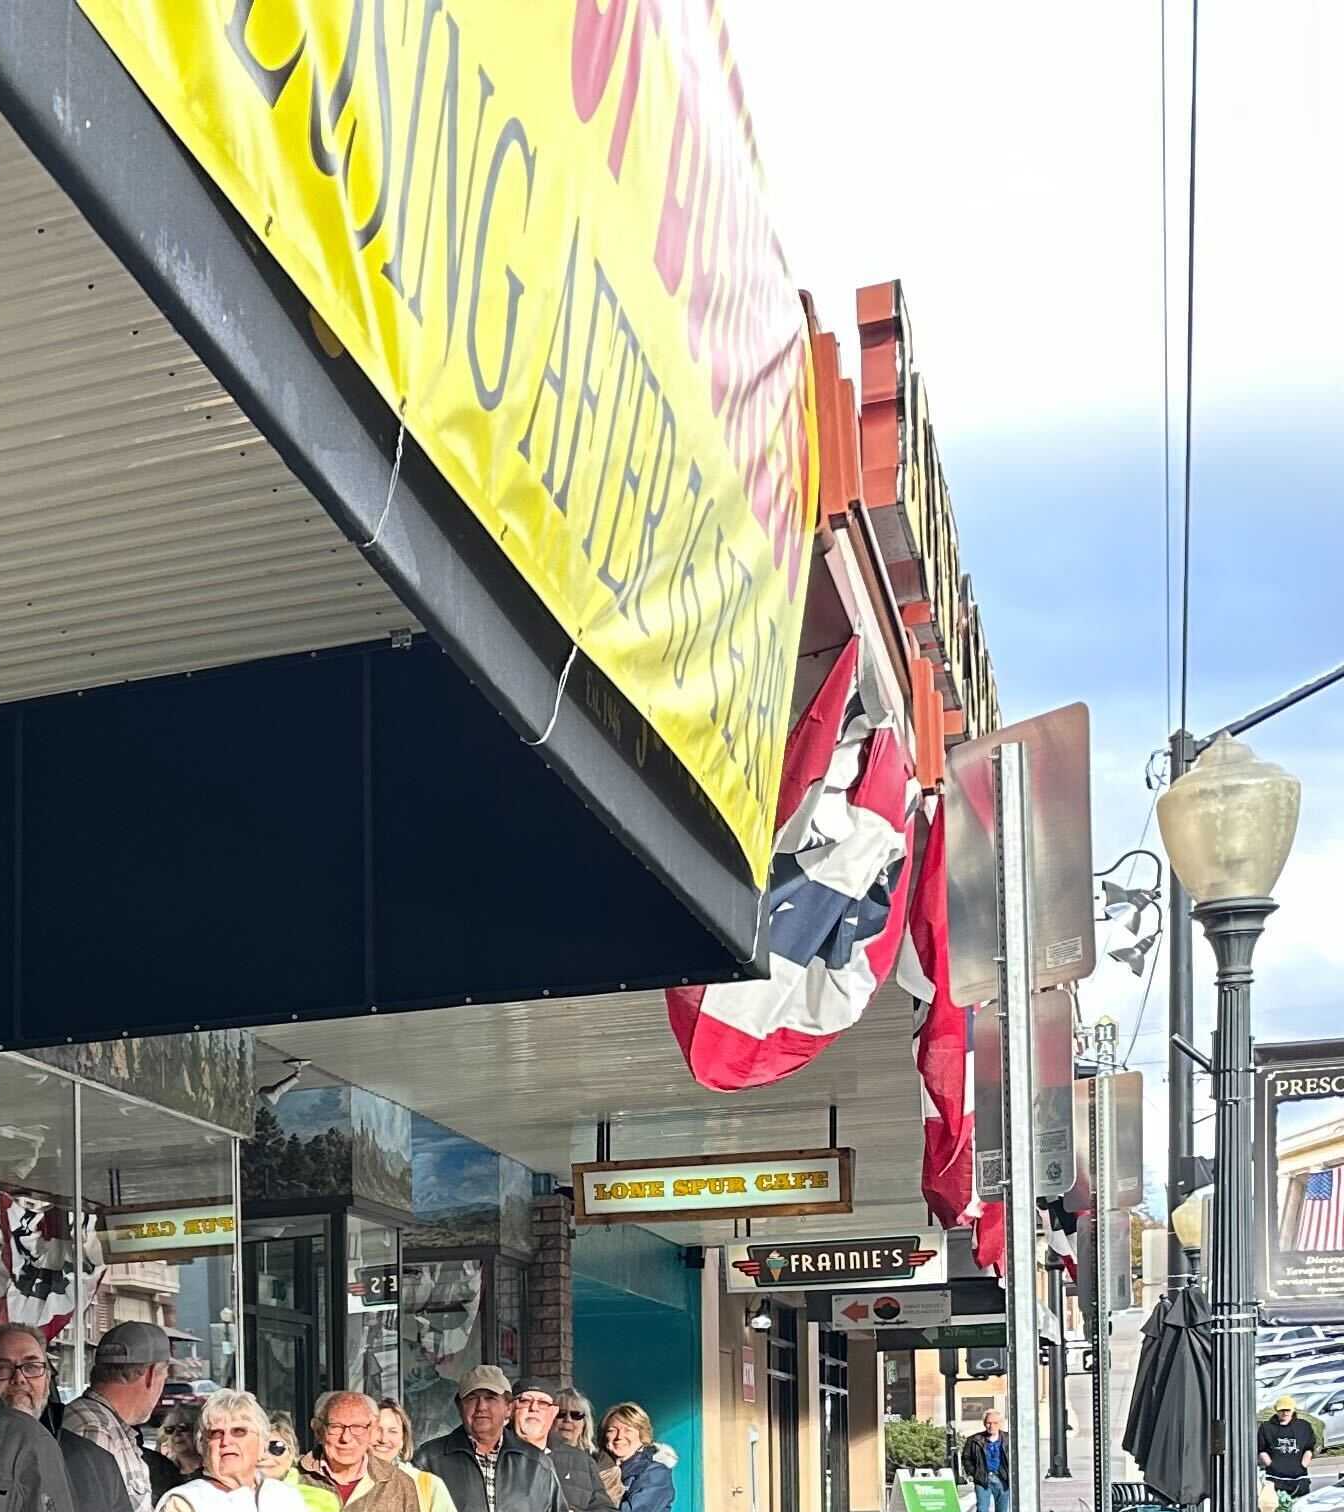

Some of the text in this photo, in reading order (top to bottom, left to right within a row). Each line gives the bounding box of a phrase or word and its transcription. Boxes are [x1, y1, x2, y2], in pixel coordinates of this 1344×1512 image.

[224, 0, 537, 412] OSING
[517, 216, 677, 638] AFTER
[662, 457, 714, 690] 76
[594, 1171, 829, 1200] LONE SPUR CAFE
[789, 1248, 905, 1273] FRANNIE'S
